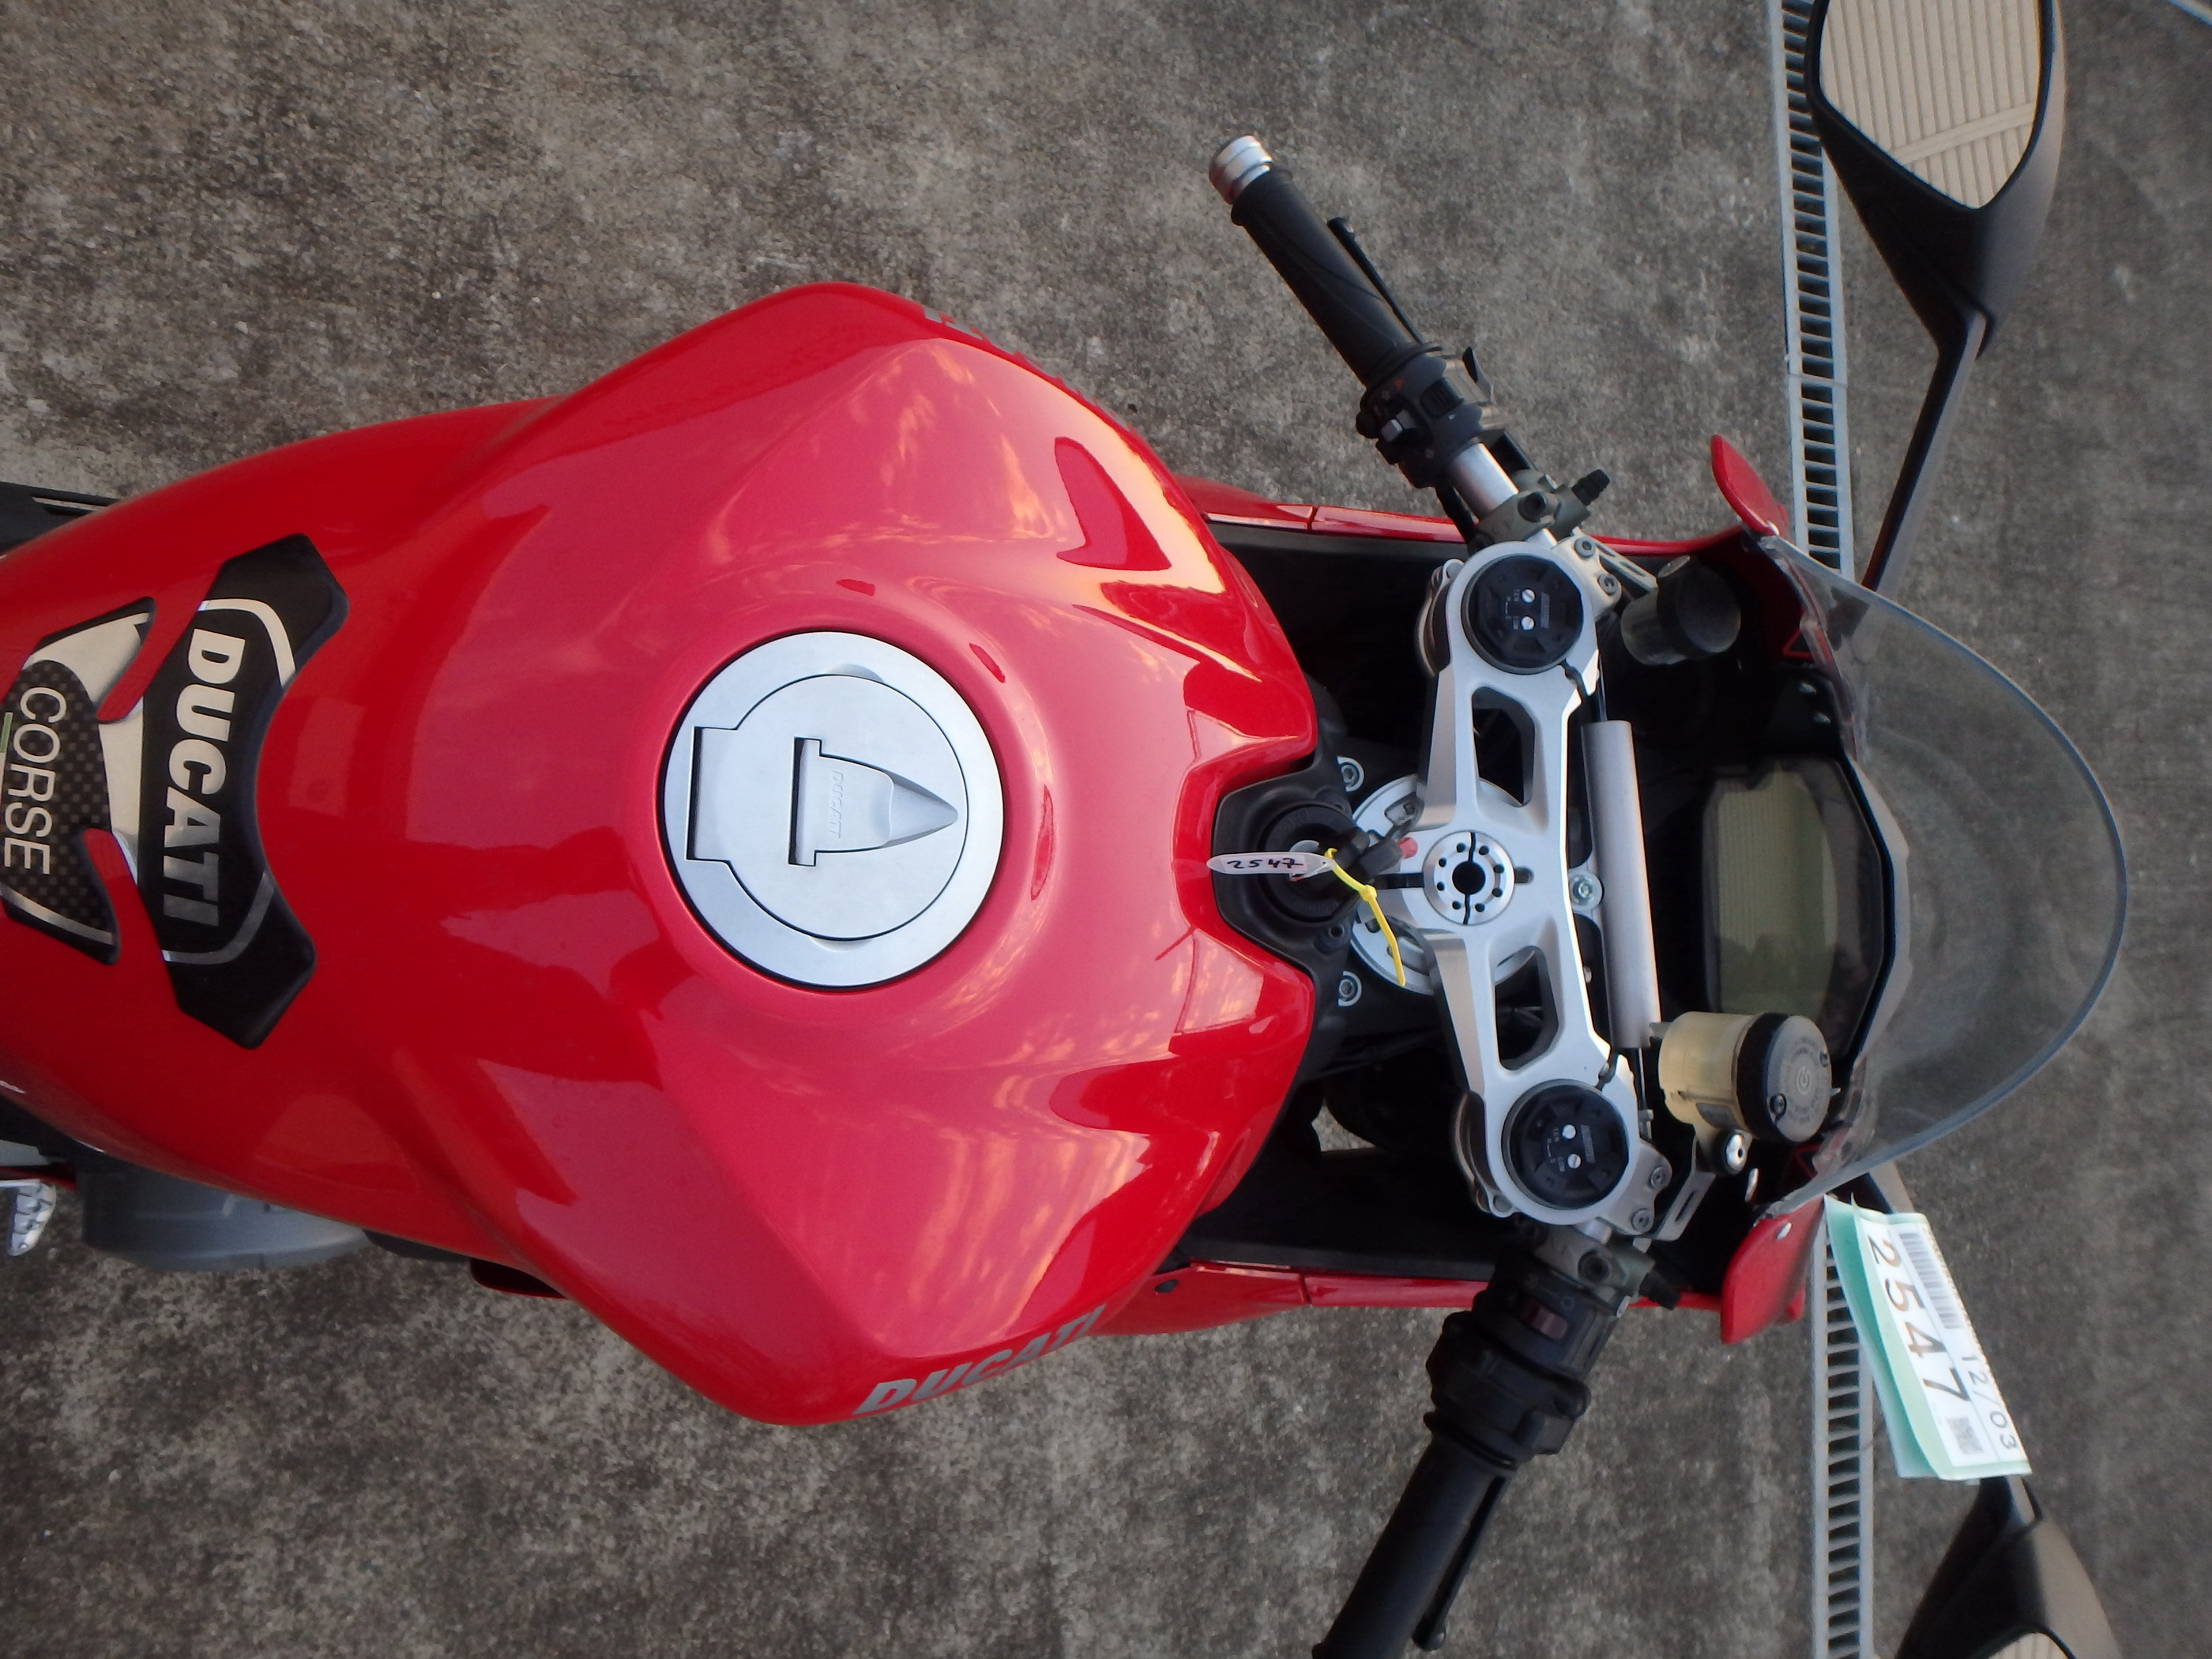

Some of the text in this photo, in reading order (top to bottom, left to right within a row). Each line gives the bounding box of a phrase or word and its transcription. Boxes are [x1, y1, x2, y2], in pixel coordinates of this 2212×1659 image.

[3, 686, 67, 875] CORSE
[162, 628, 246, 927] DUCATI
[828, 769, 845, 839] DUCATI
[1227, 857, 1304, 869] 2547
[852, 1303, 1108, 1415] DUCATI
[1867, 1235, 1971, 1403] 2547
[1961, 1353, 2018, 1450] 12/03
